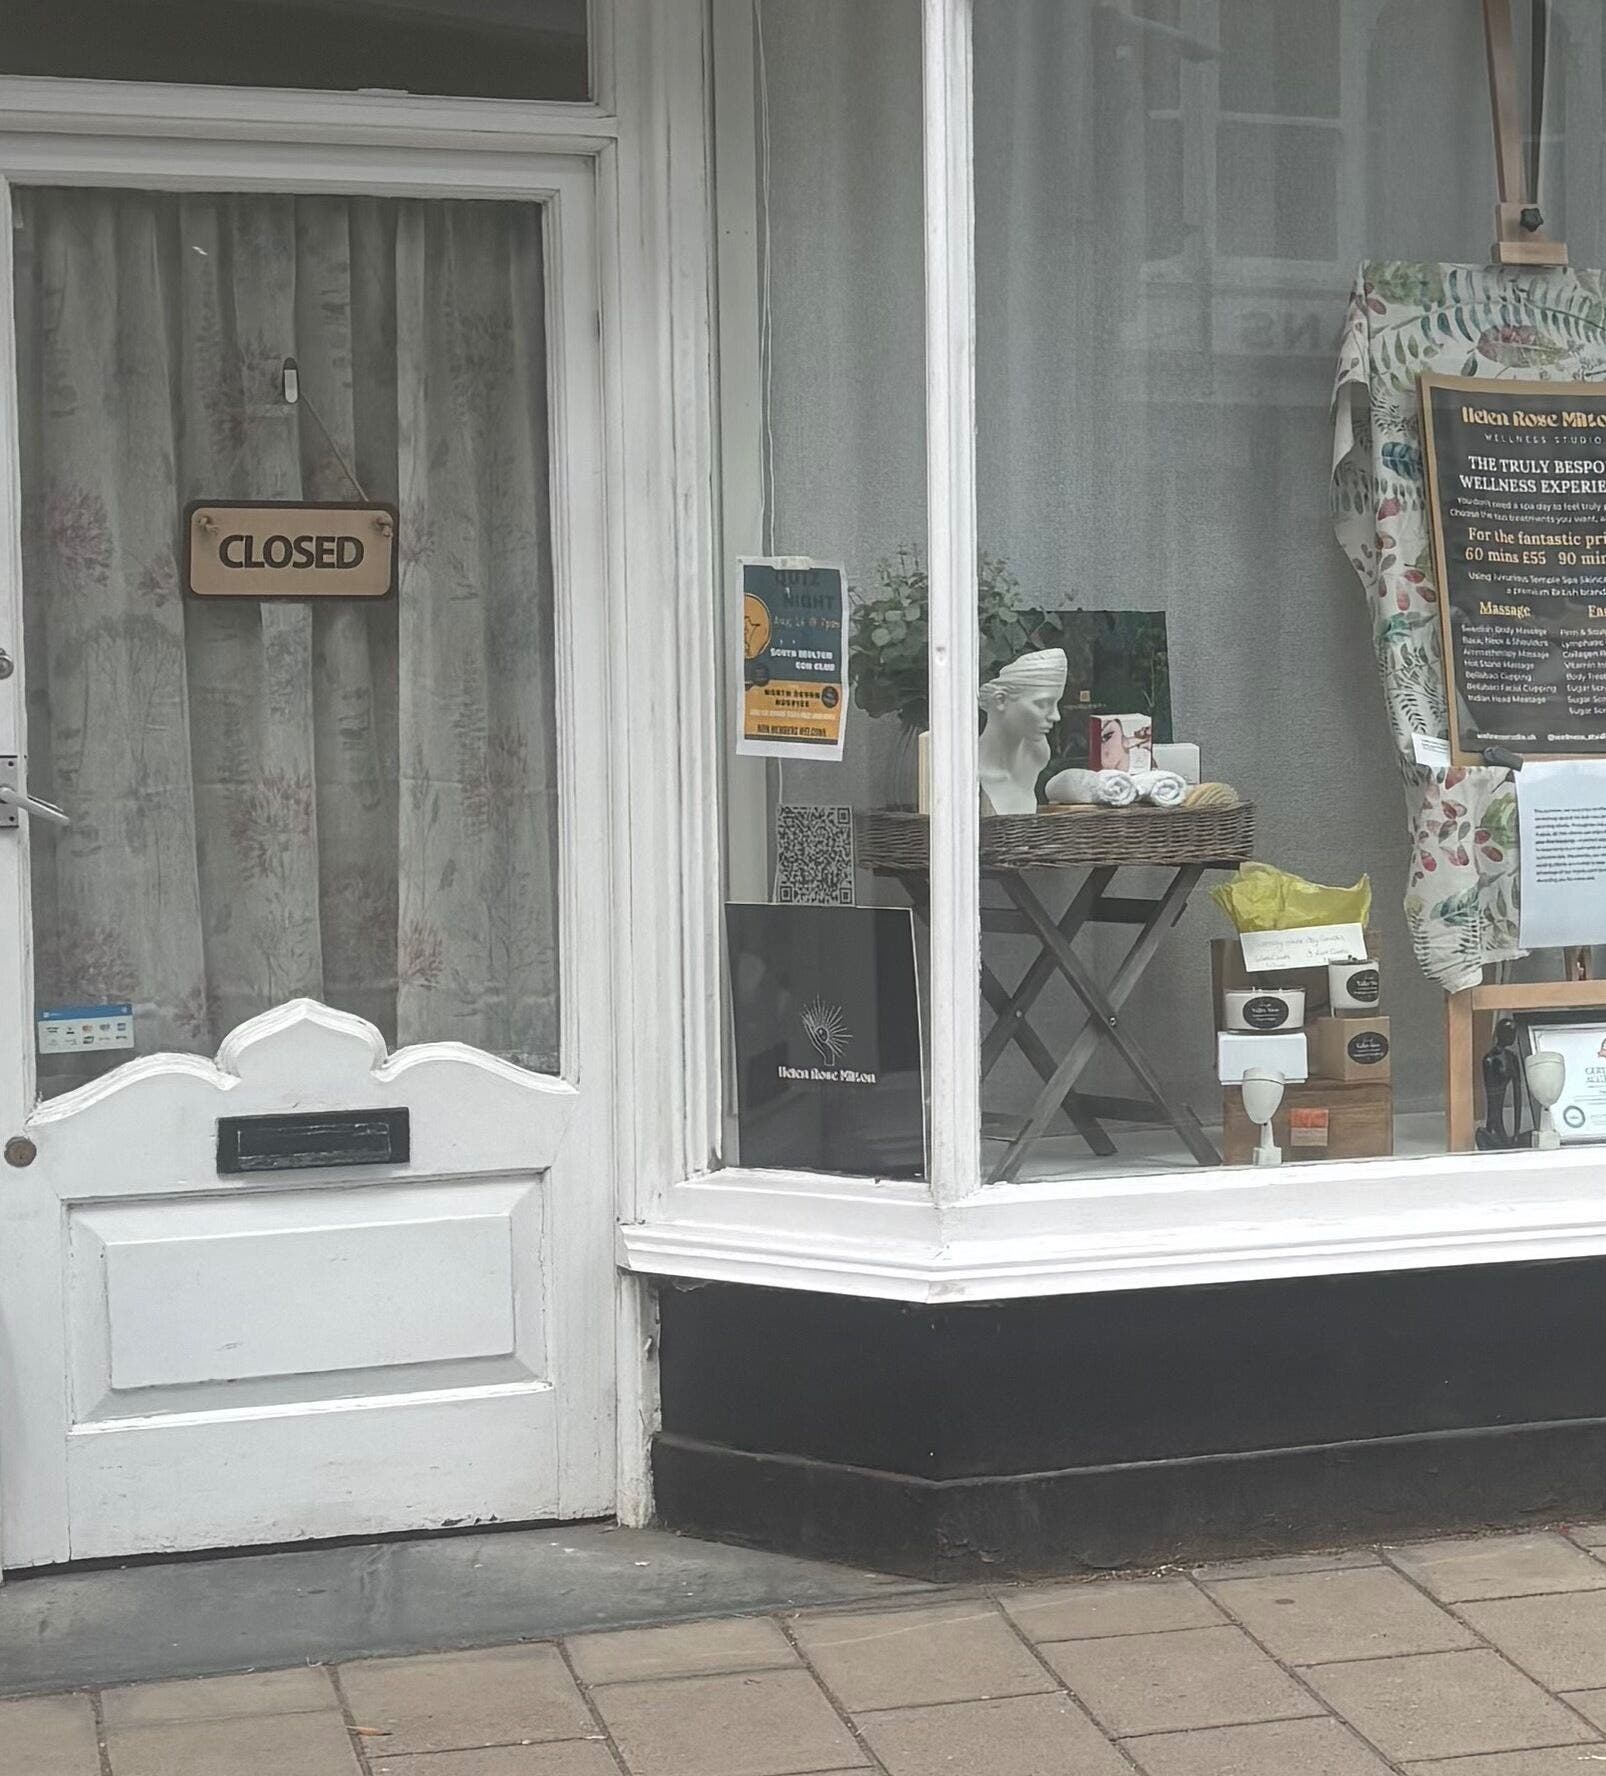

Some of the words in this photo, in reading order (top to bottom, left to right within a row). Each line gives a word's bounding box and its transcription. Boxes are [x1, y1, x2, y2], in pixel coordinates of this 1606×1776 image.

[1462, 406, 1510, 425] Helen
[1513, 410, 1559, 427] Rose
[1484, 433, 1546, 444] WELLNESS
[1554, 436, 1602, 444] STUDIO
[1468, 455, 1497, 471] THE
[1499, 459, 1550, 473] TRULY
[1459, 474, 1537, 493] WELLNESS
[1468, 527, 1491, 541] For
[1494, 528, 1515, 544] the
[1518, 531, 1581, 545] fantastic
[218, 534, 365, 569] CLOSED
[1465, 547, 1484, 561] 60
[1487, 548, 1519, 563] mins
[1522, 551, 1546, 564] £55
[1558, 551, 1577, 565] 90
[1479, 601, 1532, 619] Massage
[778, 1066, 809, 1080] Helen
[810, 1068, 839, 1081] Rose
